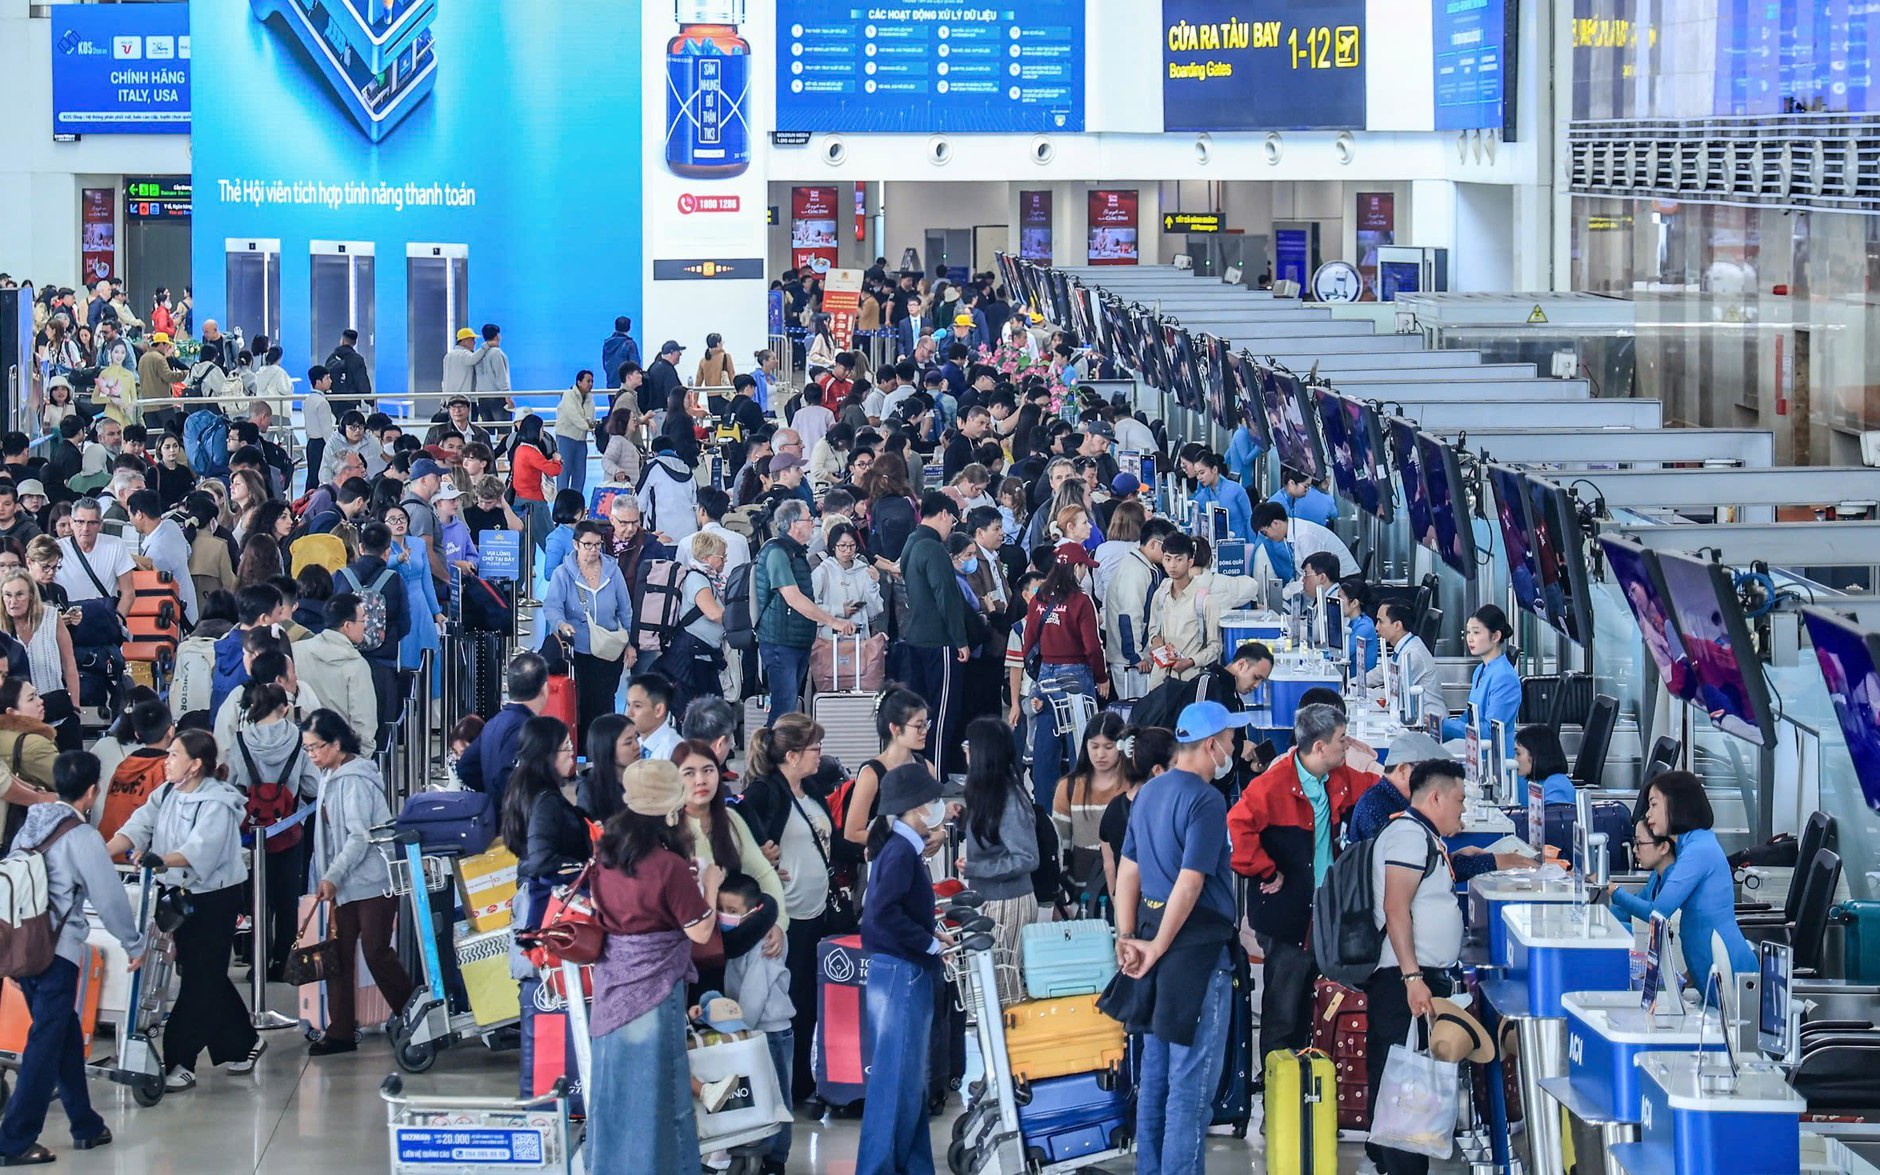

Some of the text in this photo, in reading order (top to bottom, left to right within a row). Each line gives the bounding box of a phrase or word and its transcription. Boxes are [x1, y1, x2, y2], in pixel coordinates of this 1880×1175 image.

[868, 9, 887, 20] CÁC
[887, 10, 911, 22] HOẠT
[912, 9, 937, 22] ĐỘNG
[951, 9, 962, 20] LÝ
[978, 9, 997, 22] LIỆU
[78, 41, 92, 55] KOS
[1168, 16, 1331, 69] CỬA RA TÀU BAY 1-12
[110, 68, 185, 84] CHÍNH HÃNG
[1169, 60, 1232, 81] Boarding Gates
[700, 79, 719, 90] NHUNG
[118, 89, 178, 104] ITALY, USA
[703, 109, 717, 125] THẬN
[218, 178, 476, 211] Thẻ Hội viên tích hợp tính năng thanh toán
[1569, 1031, 1583, 1066] ACV
[1641, 1094, 1653, 1131] ACV
[442, 1133, 470, 1144] 20.000
[402, 1150, 415, 1158] LIÊN
